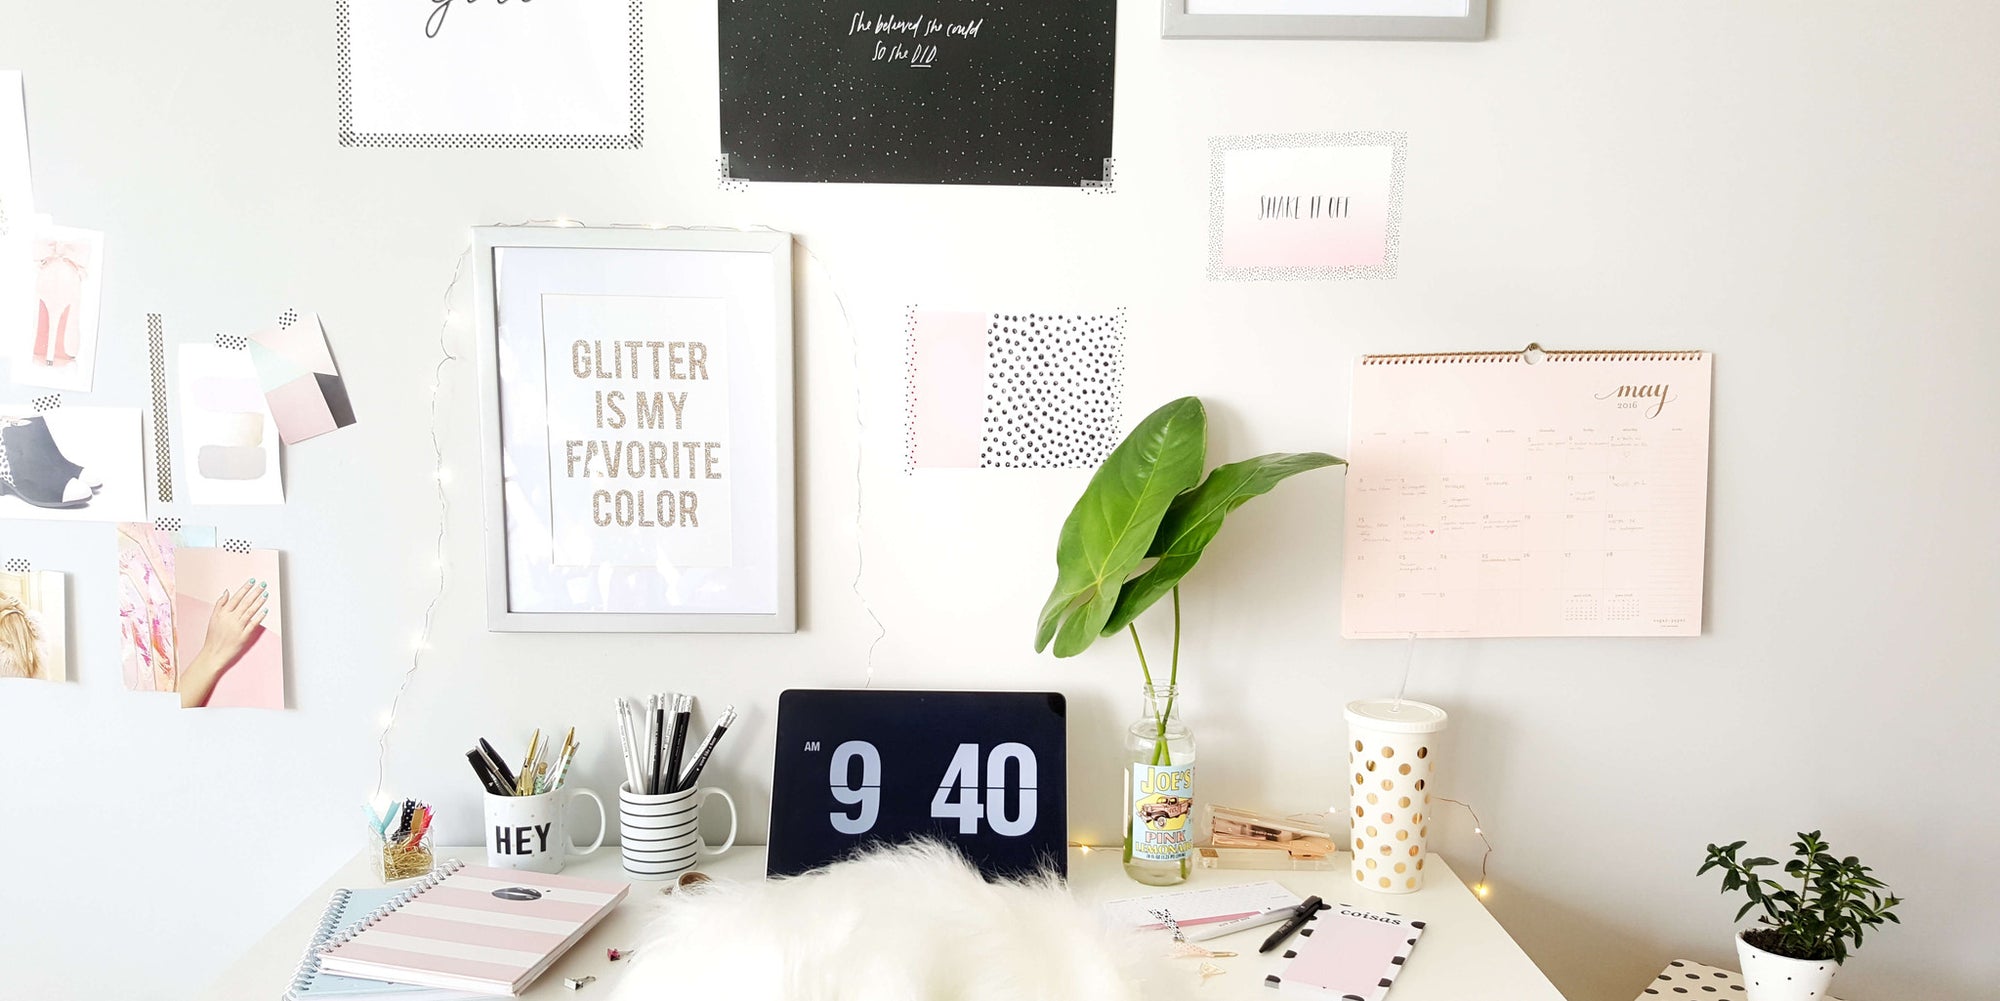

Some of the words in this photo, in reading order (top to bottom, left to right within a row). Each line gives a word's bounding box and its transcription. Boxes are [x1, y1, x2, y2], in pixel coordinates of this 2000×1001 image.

[875, 14, 923, 38] believed
[946, 18, 983, 39] could
[1257, 195, 1302, 220] SHAKE
[1310, 195, 1324, 219] IT
[571, 339, 709, 380] GLITTER
[595, 390, 627, 429] IS
[636, 391, 688, 429] MY
[1594, 384, 1678, 420] may
[1617, 401, 1638, 410] 2016
[566, 440, 722, 479] FAVORITE
[592, 489, 699, 528] COLOR
[804, 741, 821, 751] AM
[829, 740, 881, 834] 9
[931, 742, 1037, 836] 40
[1140, 766, 1192, 794] JOE'S
[495, 822, 552, 855] HEY
[1145, 830, 1187, 845] PINK
[1340, 909, 1402, 926] coisas
